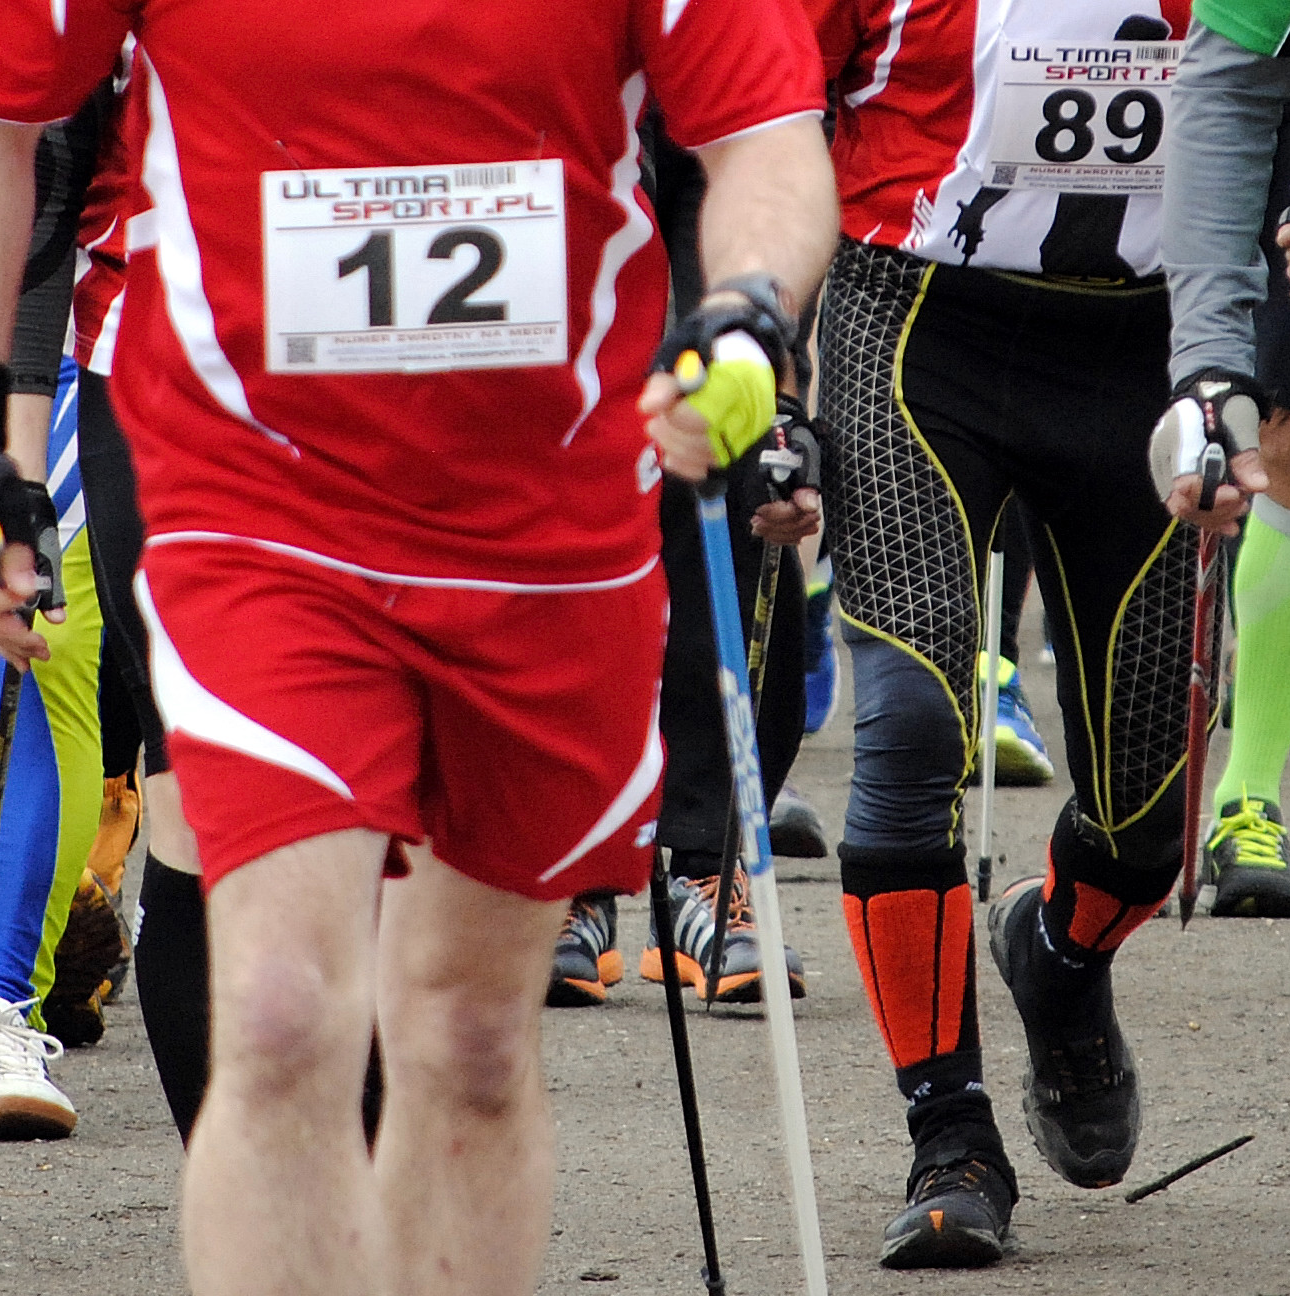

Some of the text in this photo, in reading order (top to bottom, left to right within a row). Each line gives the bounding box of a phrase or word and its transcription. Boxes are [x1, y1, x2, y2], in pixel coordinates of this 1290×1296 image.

[1010, 46, 1133, 63] ULTIMA
[1034, 88, 1165, 164] 89
[282, 174, 451, 200] ULTIMA
[332, 192, 554, 221] SPORT.PL
[337, 225, 509, 328] 12
